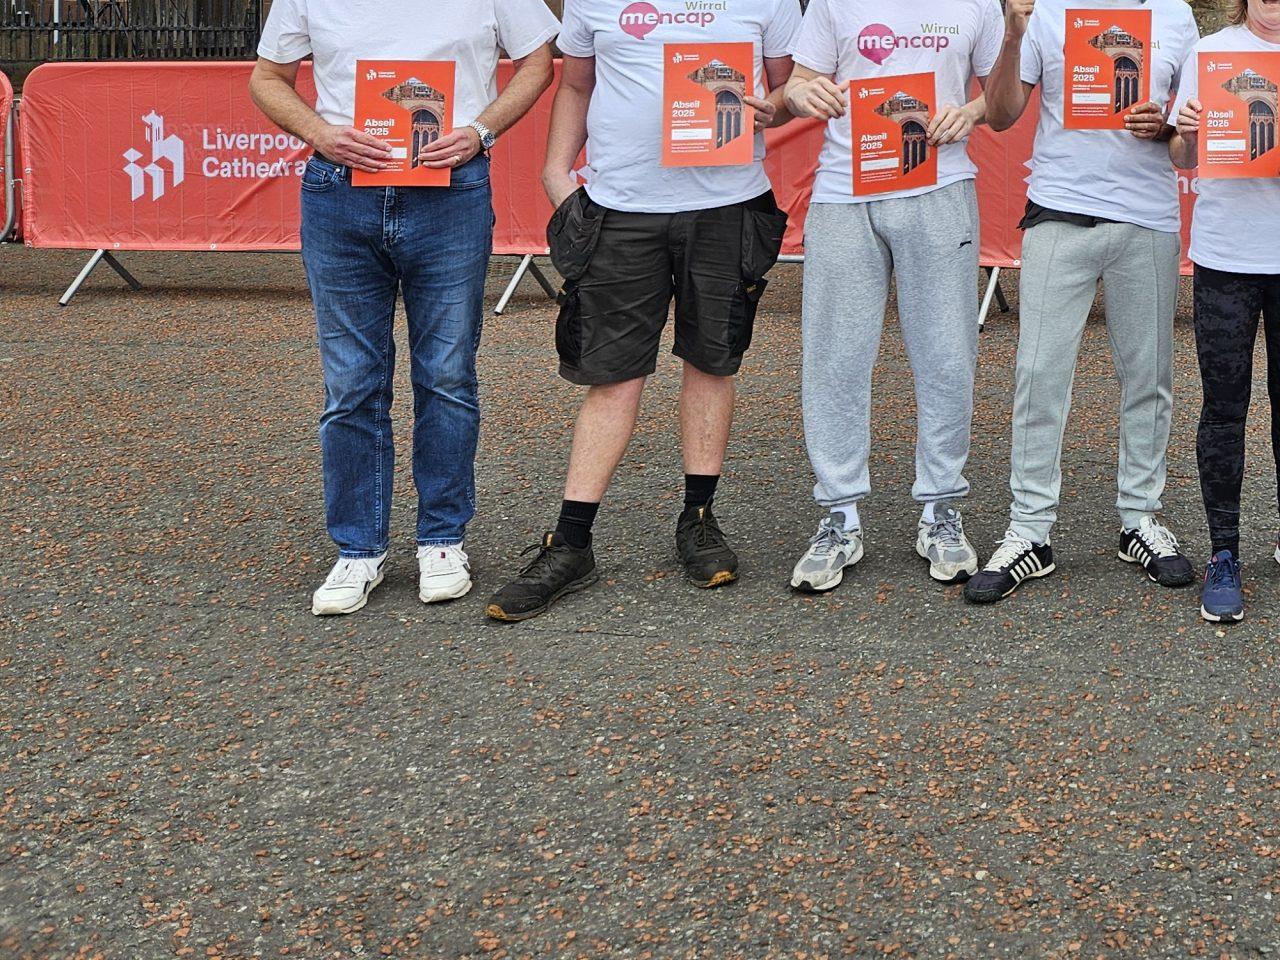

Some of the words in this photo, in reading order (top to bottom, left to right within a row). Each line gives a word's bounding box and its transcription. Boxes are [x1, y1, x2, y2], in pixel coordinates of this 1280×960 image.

[685, 0, 727, 10] Wirral
[621, 11, 715, 27] mencap
[920, 22, 960, 35] Wirral
[859, 34, 949, 52] mencap
[1073, 65, 1100, 73] Abseil
[1073, 74, 1095, 82] 2025
[672, 100, 700, 108] Abseil
[672, 109, 695, 117] 2025
[1207, 110, 1233, 118] Abseil
[364, 118, 395, 127] Abseil
[1207, 119, 1229, 127] 2025
[202, 128, 306, 154] Liverpoo
[860, 132, 887, 143] Abseil
[860, 141, 883, 150] 2025
[202, 156, 306, 178] Cathedra
